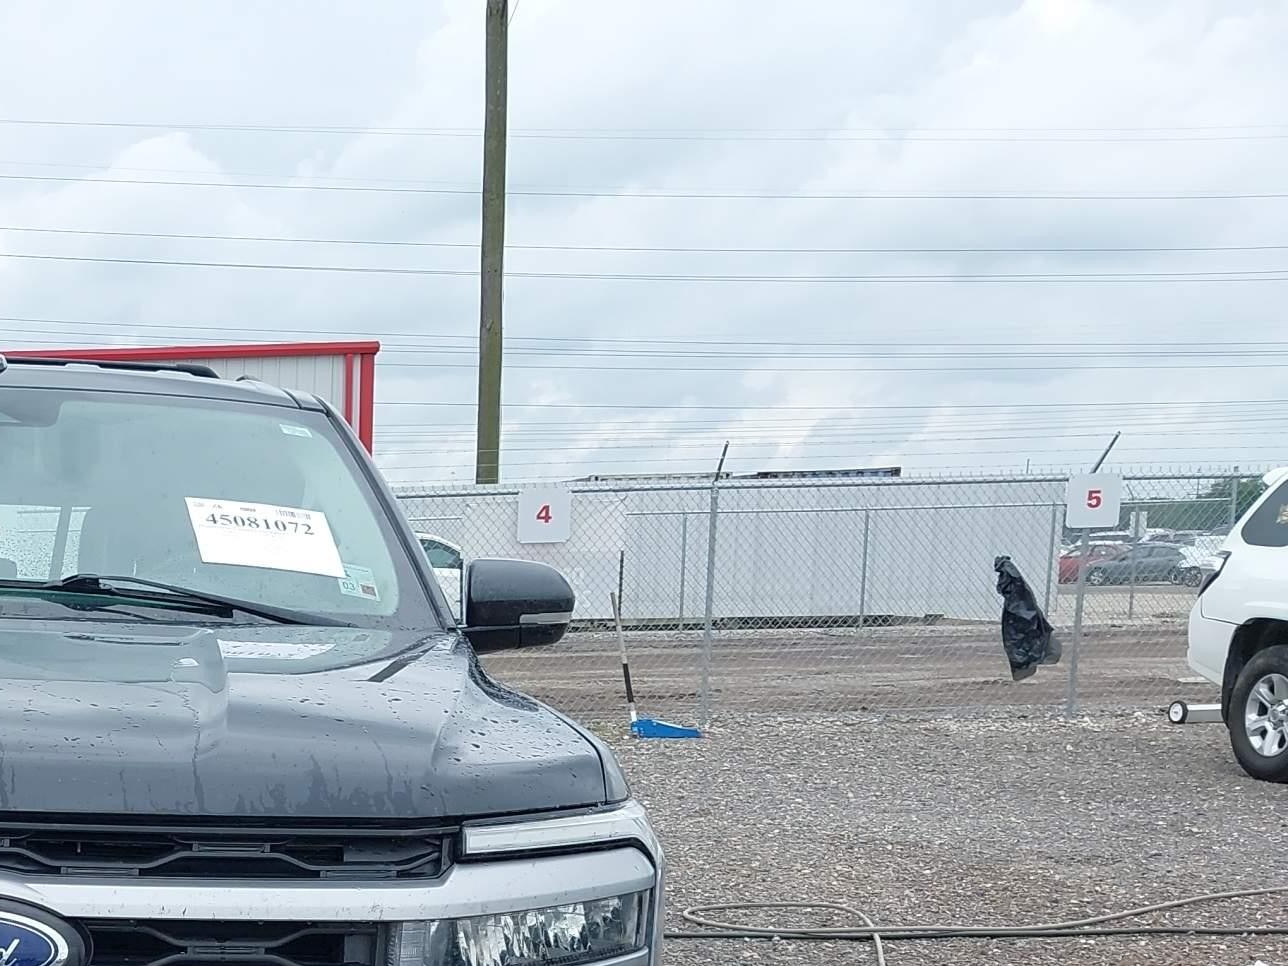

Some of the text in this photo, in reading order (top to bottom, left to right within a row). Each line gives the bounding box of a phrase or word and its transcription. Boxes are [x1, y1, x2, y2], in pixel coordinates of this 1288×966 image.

[1086, 489, 1102, 509] 5
[205, 512, 315, 536] 45081072
[535, 504, 553, 524] 4
